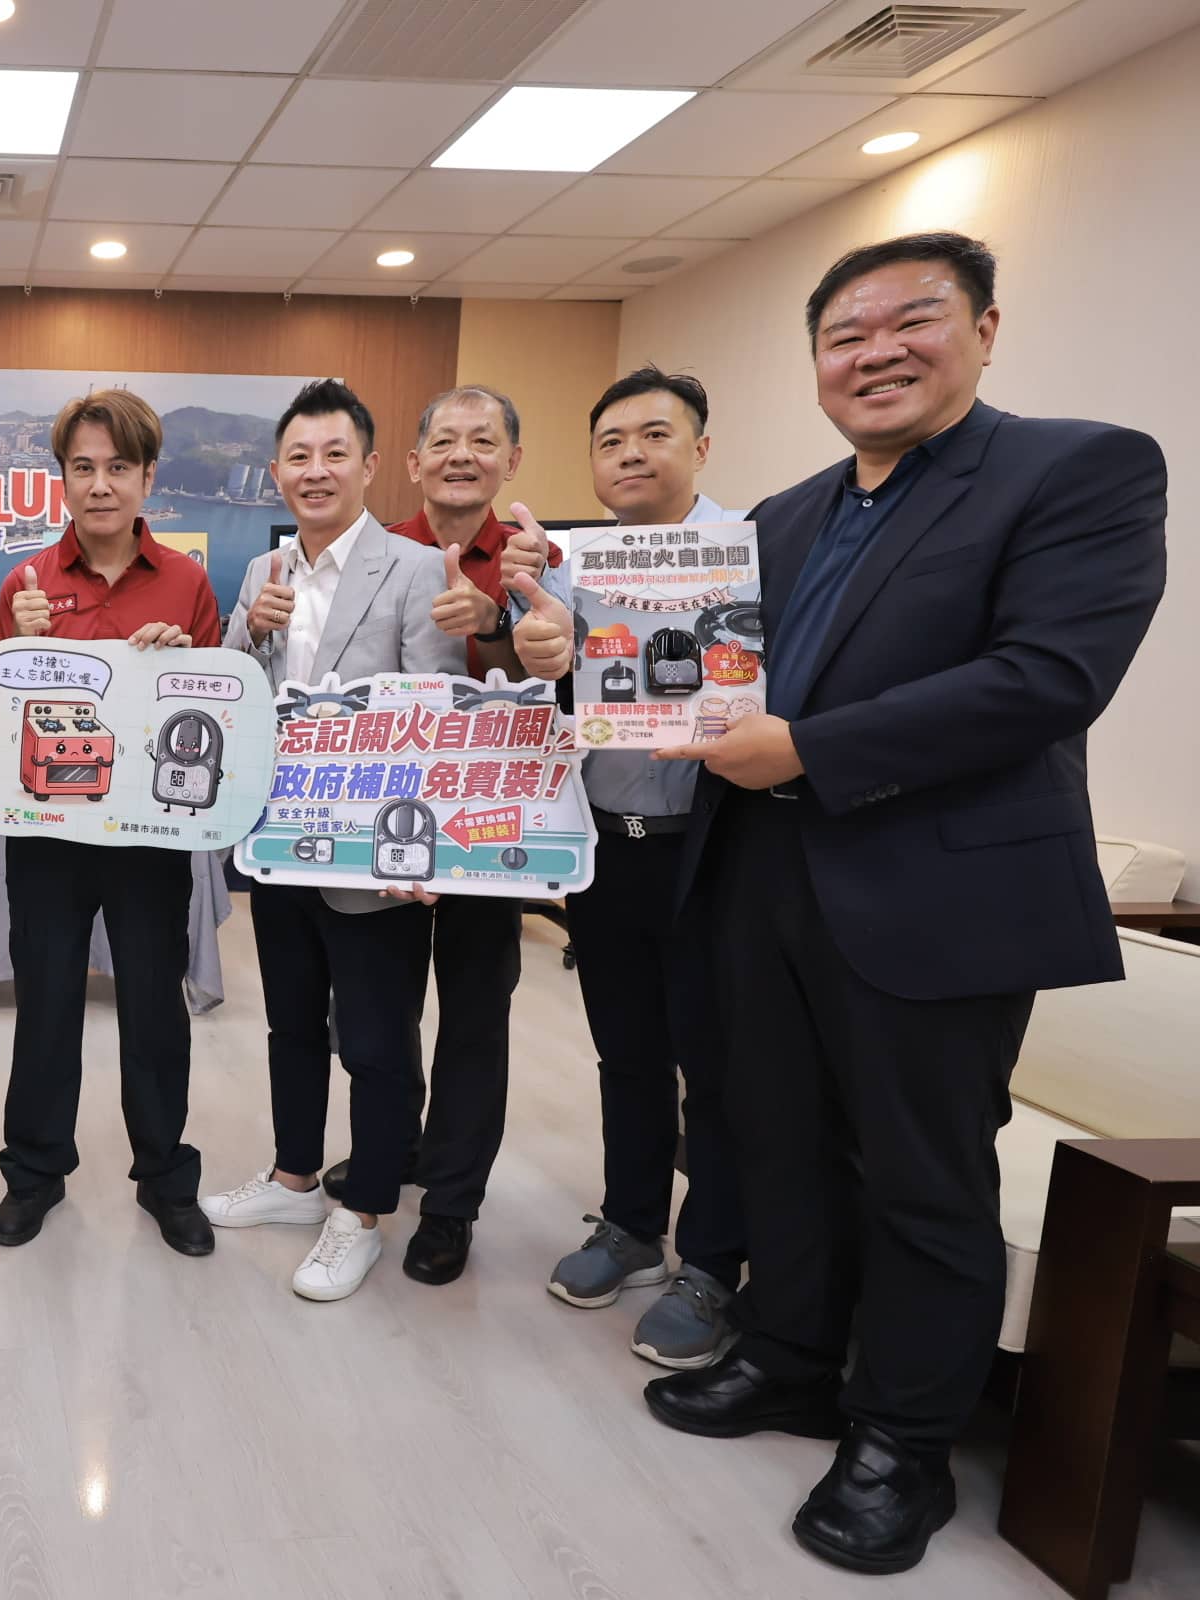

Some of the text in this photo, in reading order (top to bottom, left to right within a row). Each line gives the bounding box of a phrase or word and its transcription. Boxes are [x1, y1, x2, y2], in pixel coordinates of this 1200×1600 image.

[581, 546, 750, 570] 瓦斯爐火自動關
[32, 656, 70, 669] 好擔心
[169, 678, 231, 693] 交給我吧!
[400, 681, 445, 690] KEELUNG
[270, 761, 569, 800] 政府補助免費裝!
[23, 810, 65, 823] KEELUNG
[278, 807, 330, 819] 安全升級
[120, 823, 180, 837] 基隆市消防局
[304, 821, 357, 833] 守護家人
[467, 824, 516, 841] 直接裝!
